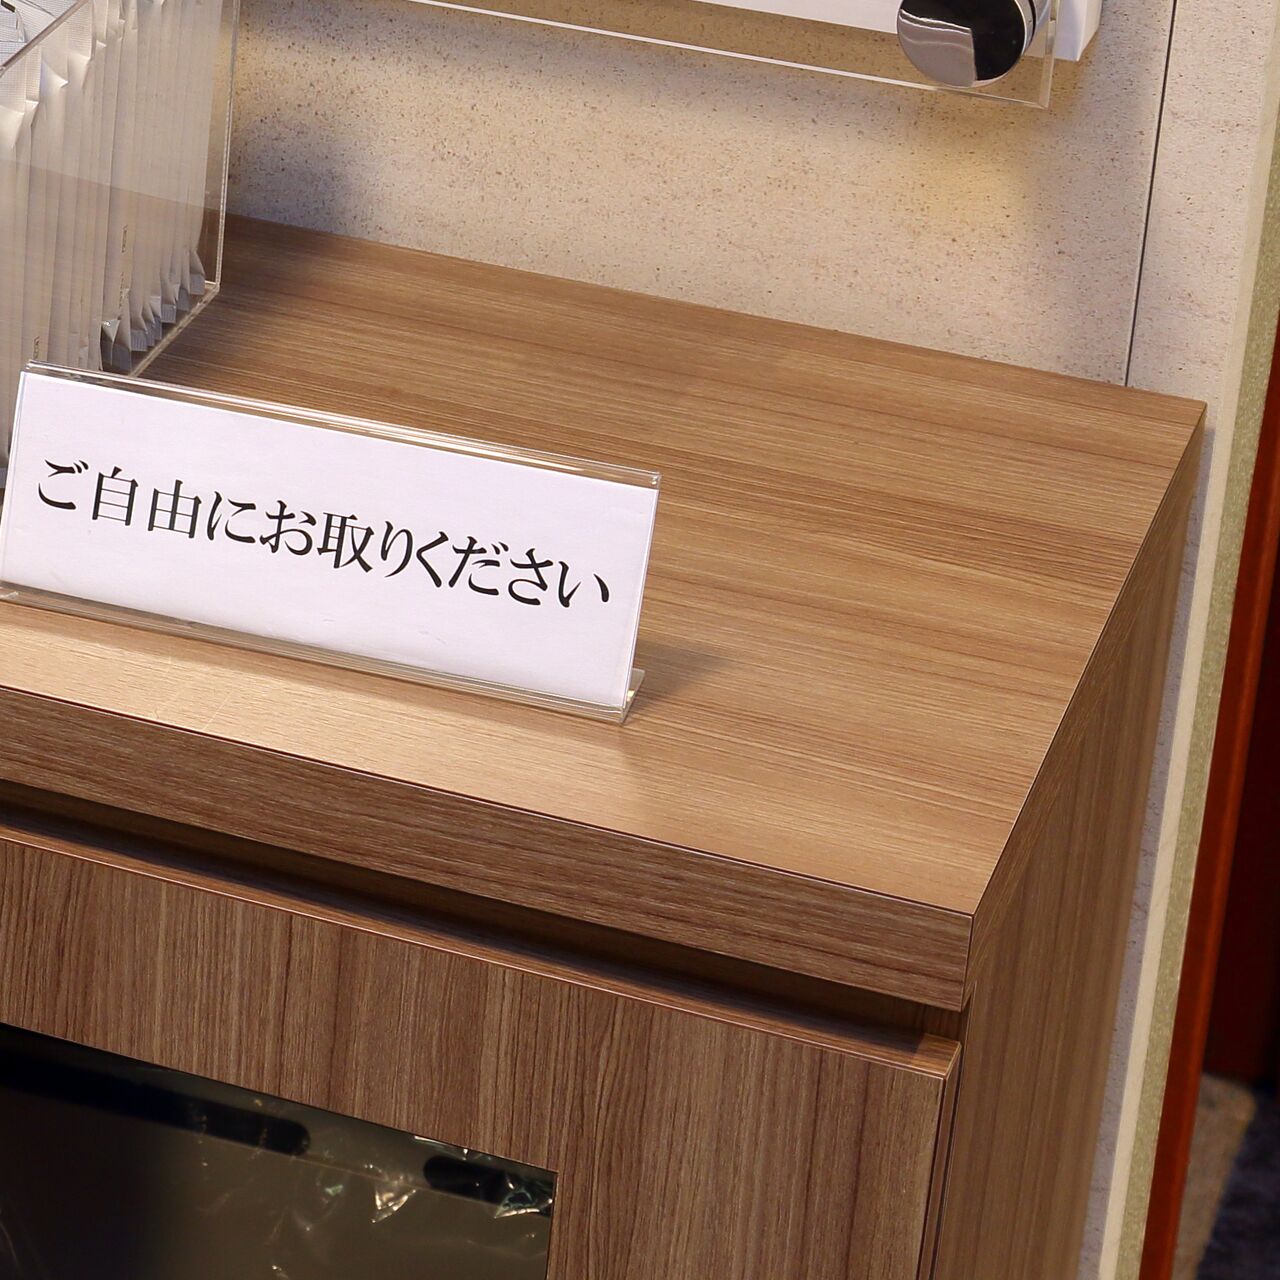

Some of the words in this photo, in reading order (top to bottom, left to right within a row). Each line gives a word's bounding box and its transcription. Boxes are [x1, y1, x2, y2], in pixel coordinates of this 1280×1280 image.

[38, 458, 611, 609] ご自由にお取りください
